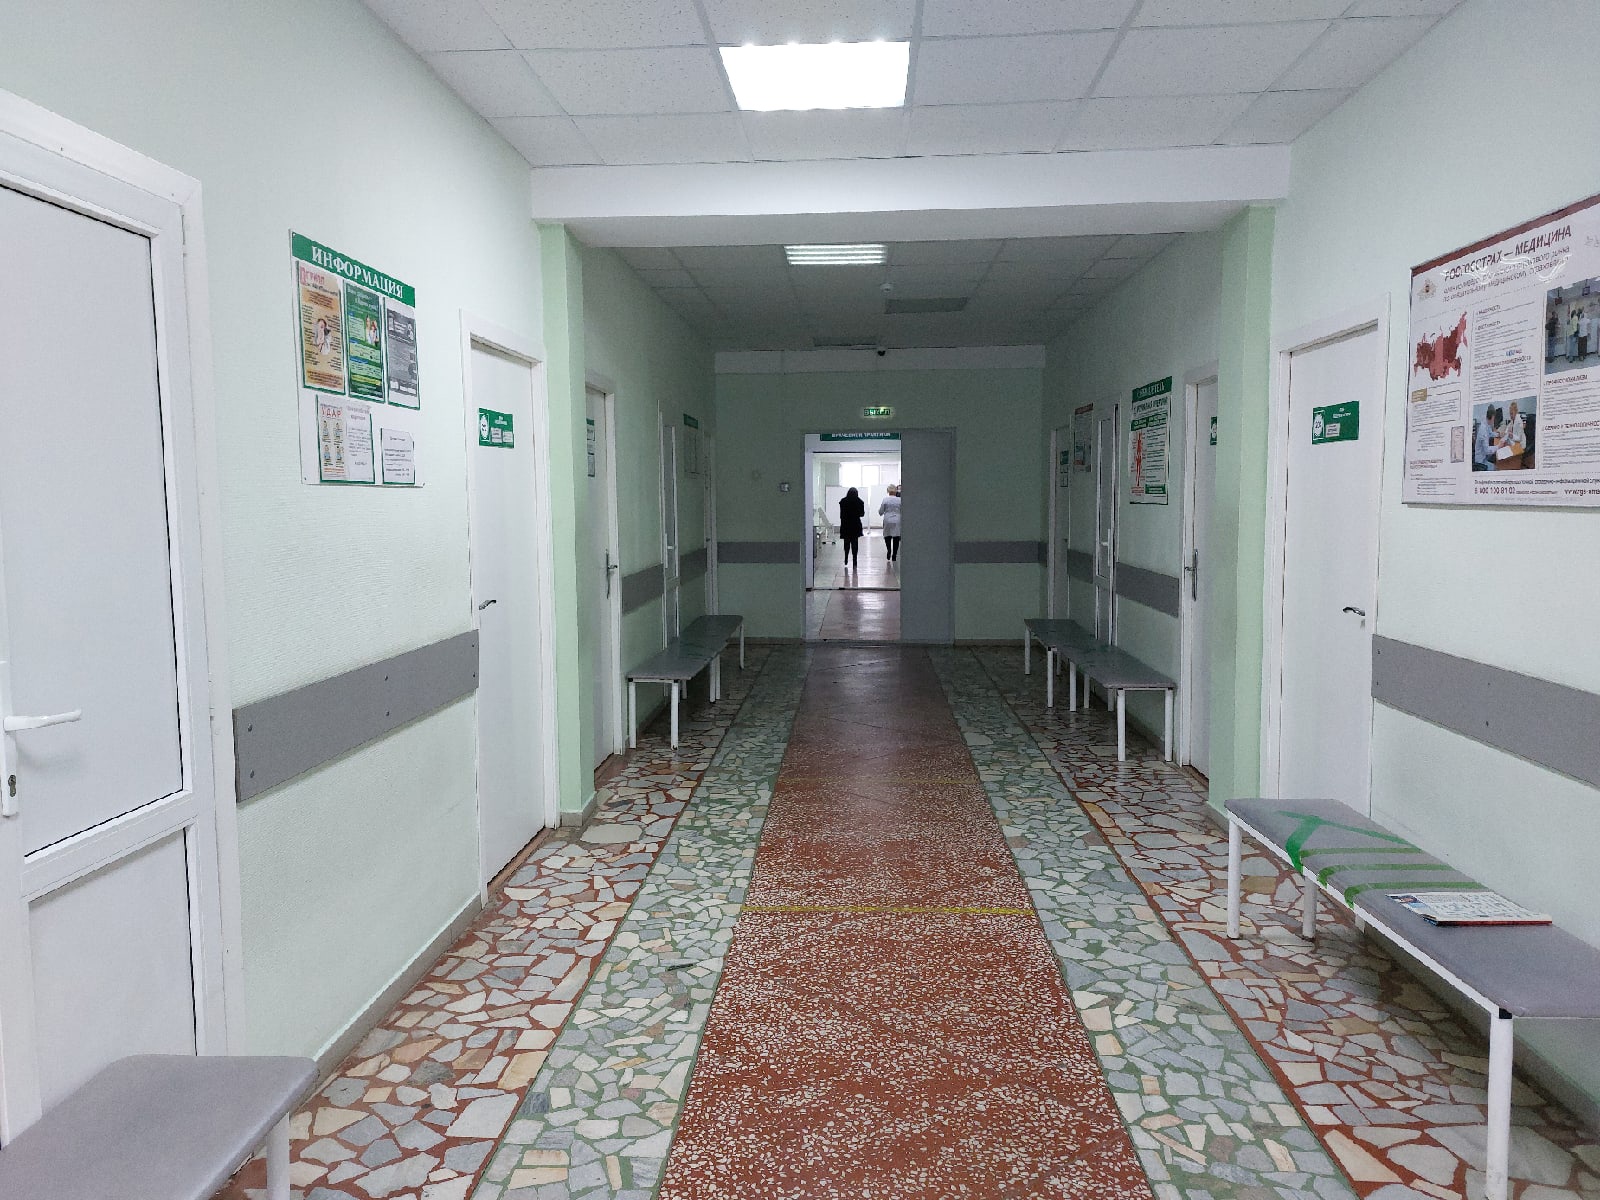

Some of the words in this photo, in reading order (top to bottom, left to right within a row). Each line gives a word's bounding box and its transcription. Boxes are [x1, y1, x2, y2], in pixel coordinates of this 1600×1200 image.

[1514, 225, 1572, 256] МЕДИЦИНА
[312, 246, 404, 298] ИНФОРМАЦИЯ
[864, 408, 890, 416] ВЫХОД
